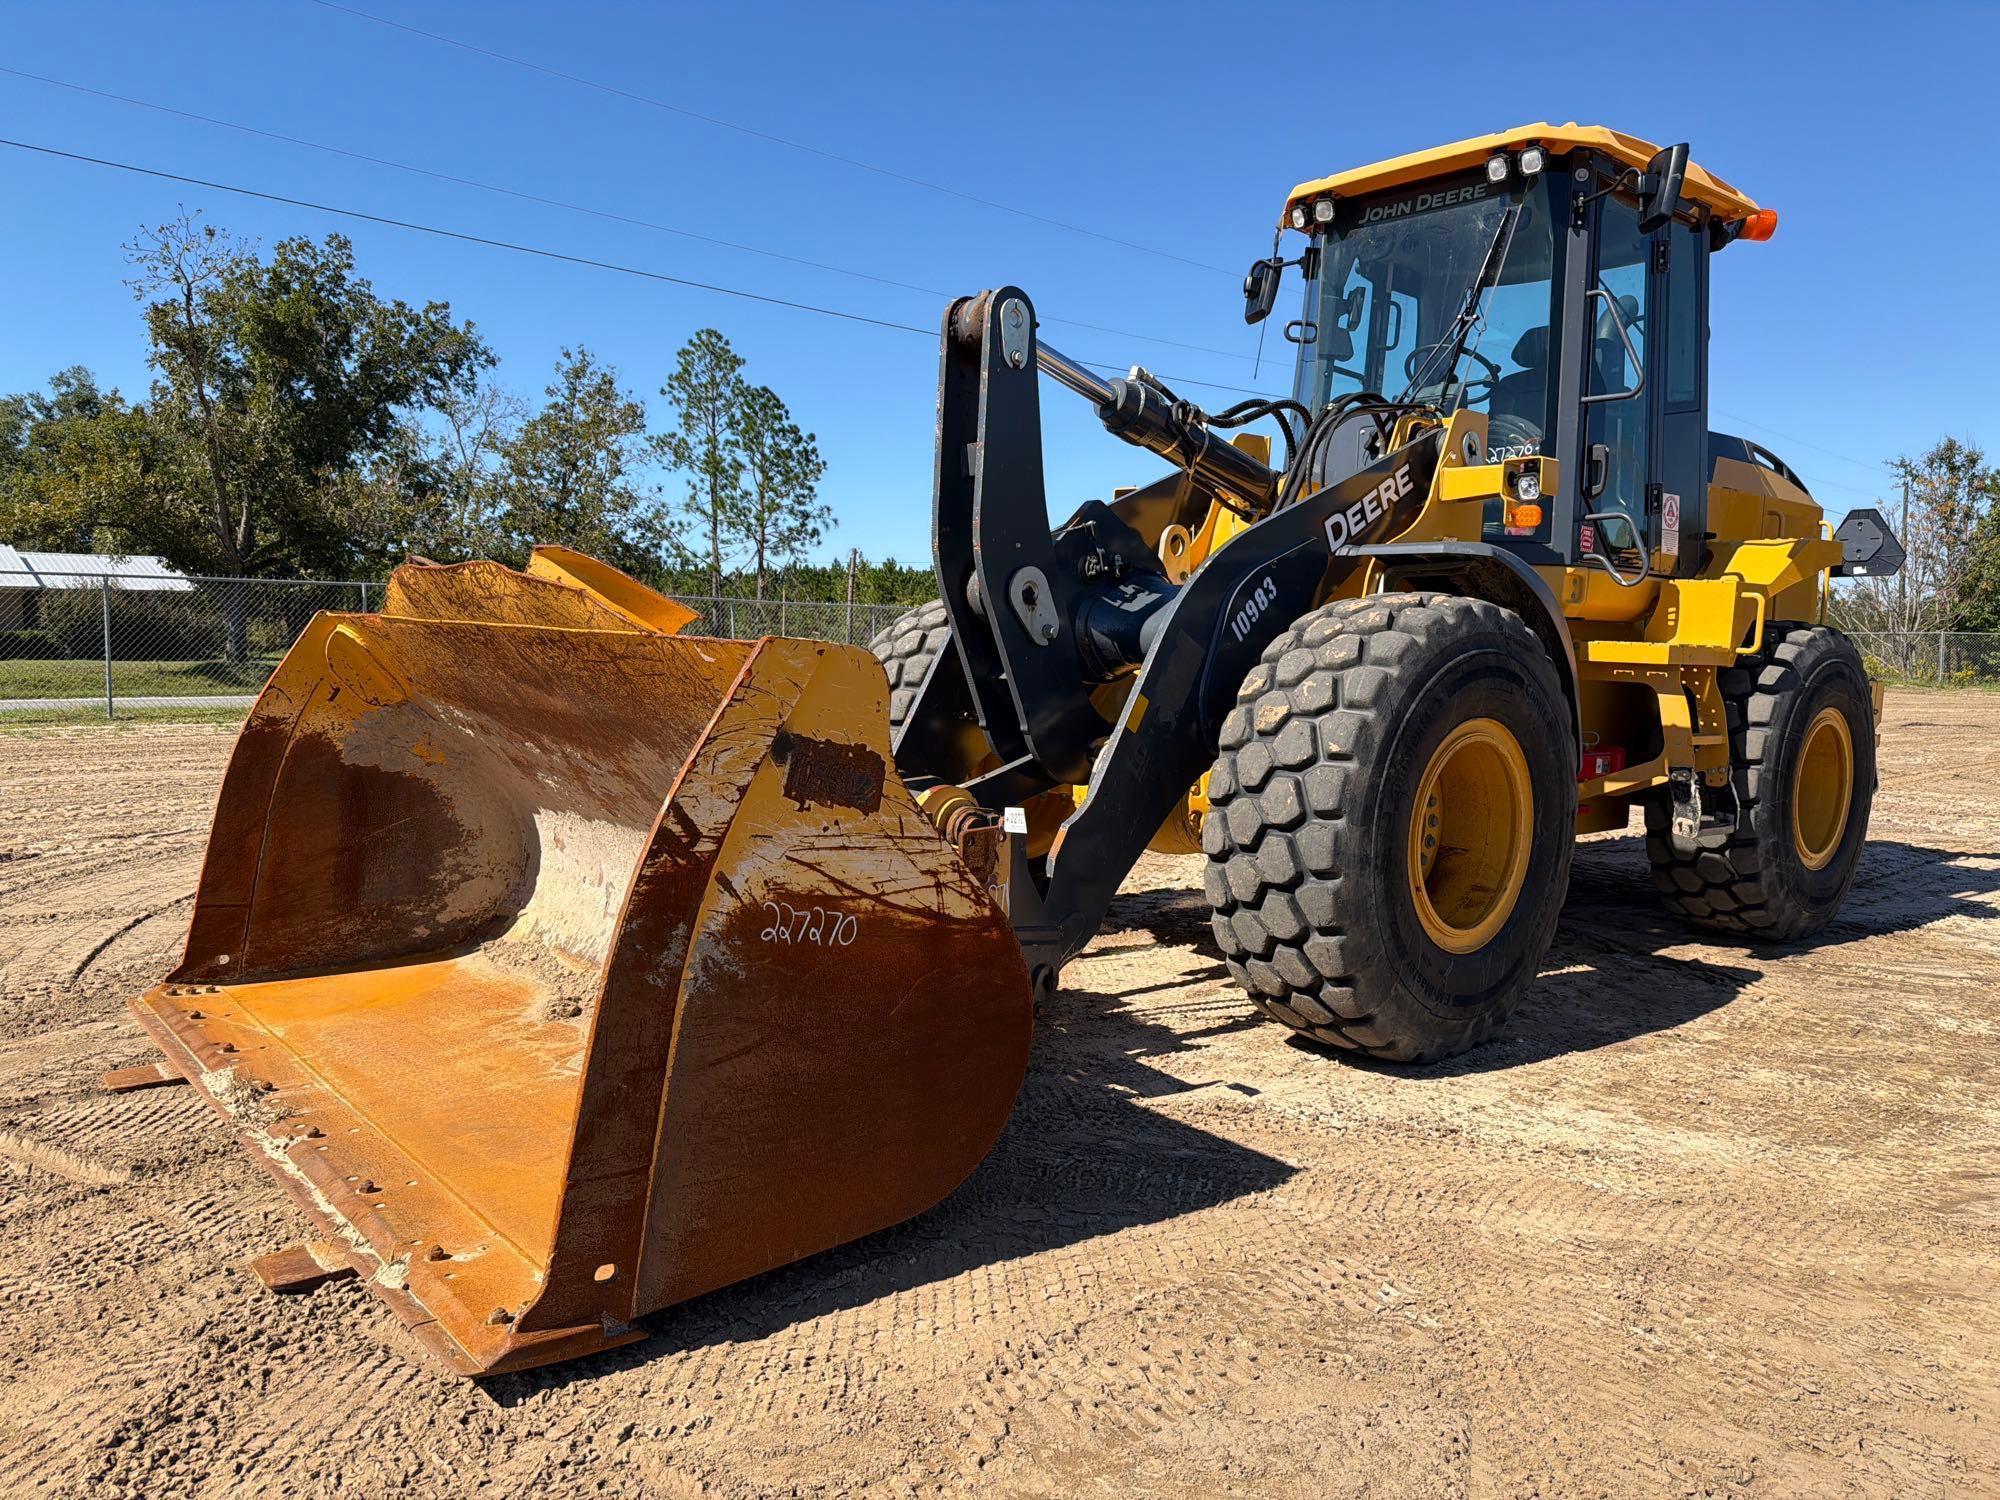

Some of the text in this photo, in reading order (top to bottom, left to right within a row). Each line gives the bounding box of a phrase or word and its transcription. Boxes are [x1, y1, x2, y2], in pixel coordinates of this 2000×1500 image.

[1358, 183, 1488, 224] JOHN DEERE
[1485, 443, 1533, 464] 27270
[1324, 463, 1414, 553] DEERE
[1230, 576, 1278, 642] 10983
[760, 901, 857, 946] 227270
